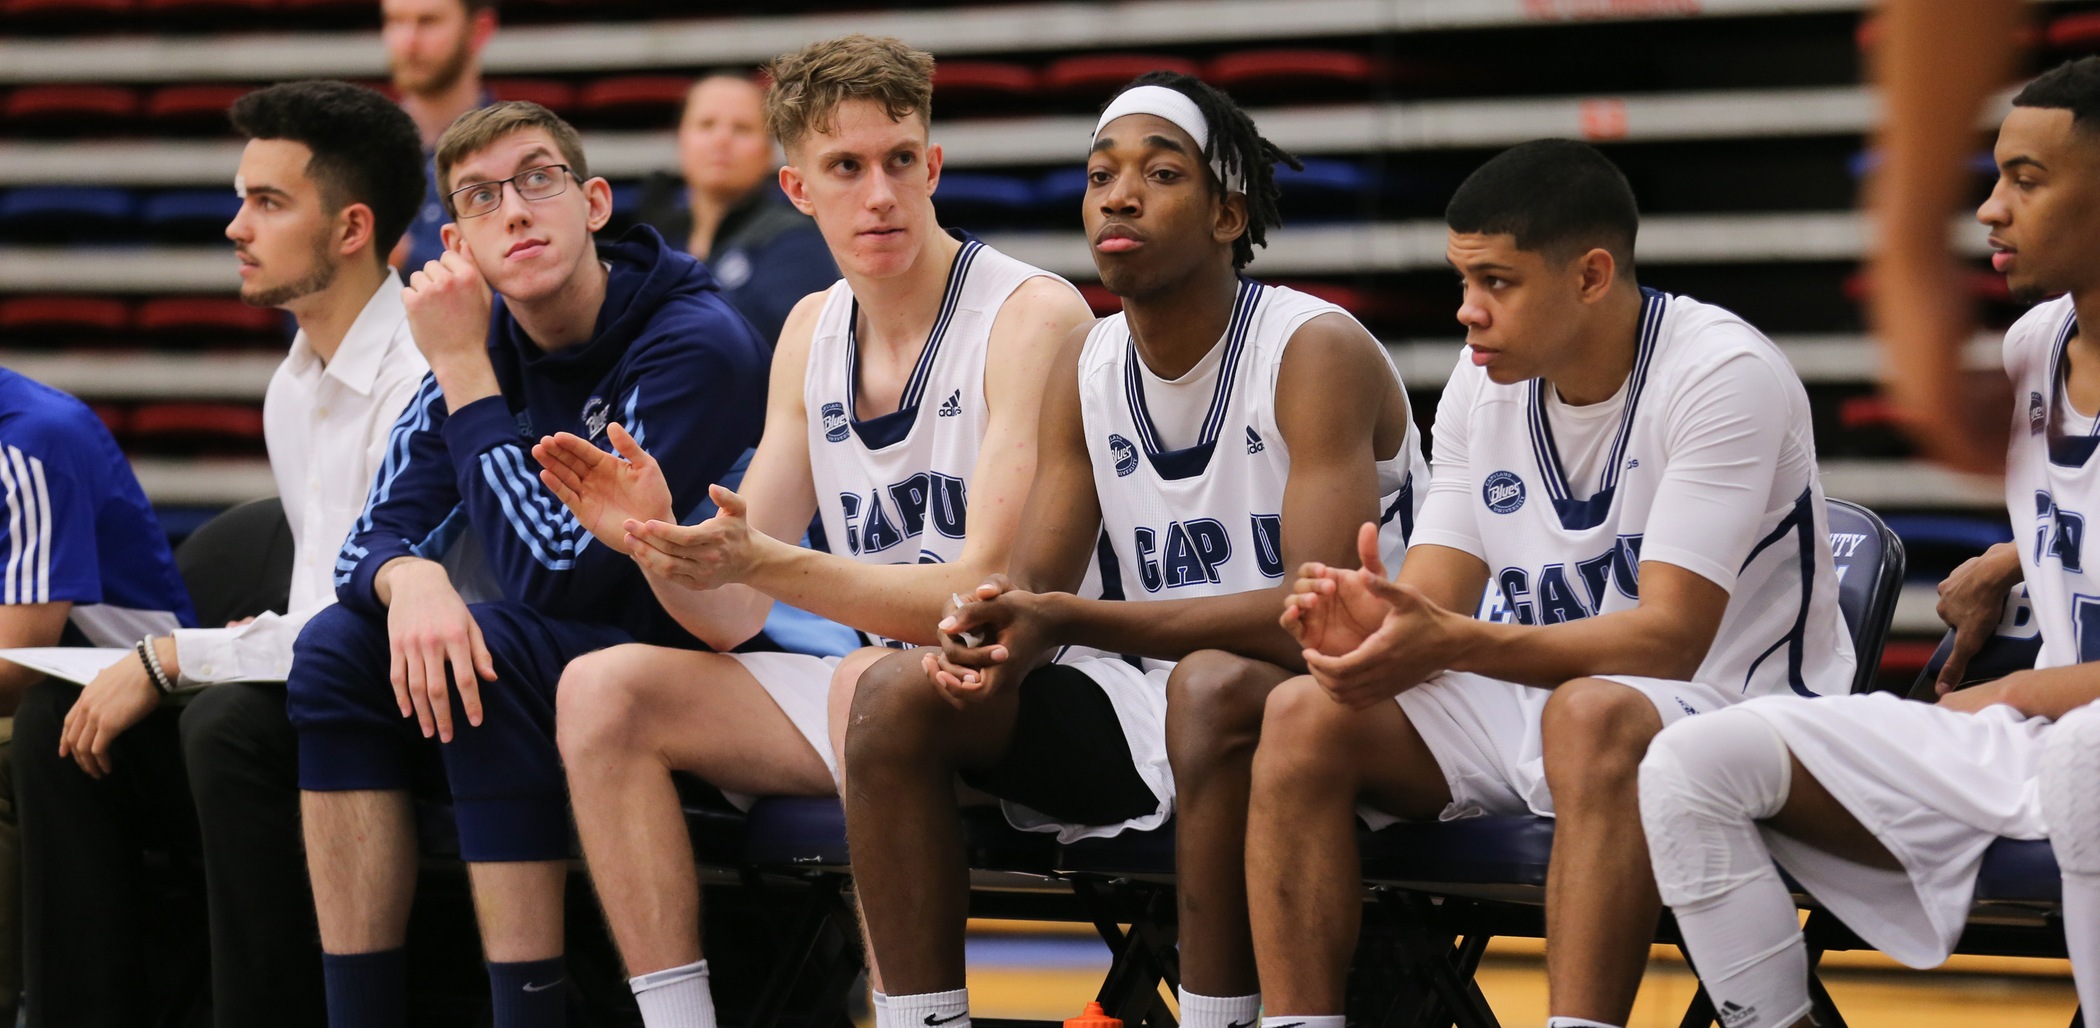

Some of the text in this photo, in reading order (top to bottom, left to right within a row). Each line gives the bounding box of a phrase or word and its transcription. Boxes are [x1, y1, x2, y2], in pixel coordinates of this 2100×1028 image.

[823, 413, 848, 435] Blue
[1488, 481, 1521, 507] Blues
[1134, 517, 1232, 592] CAP
